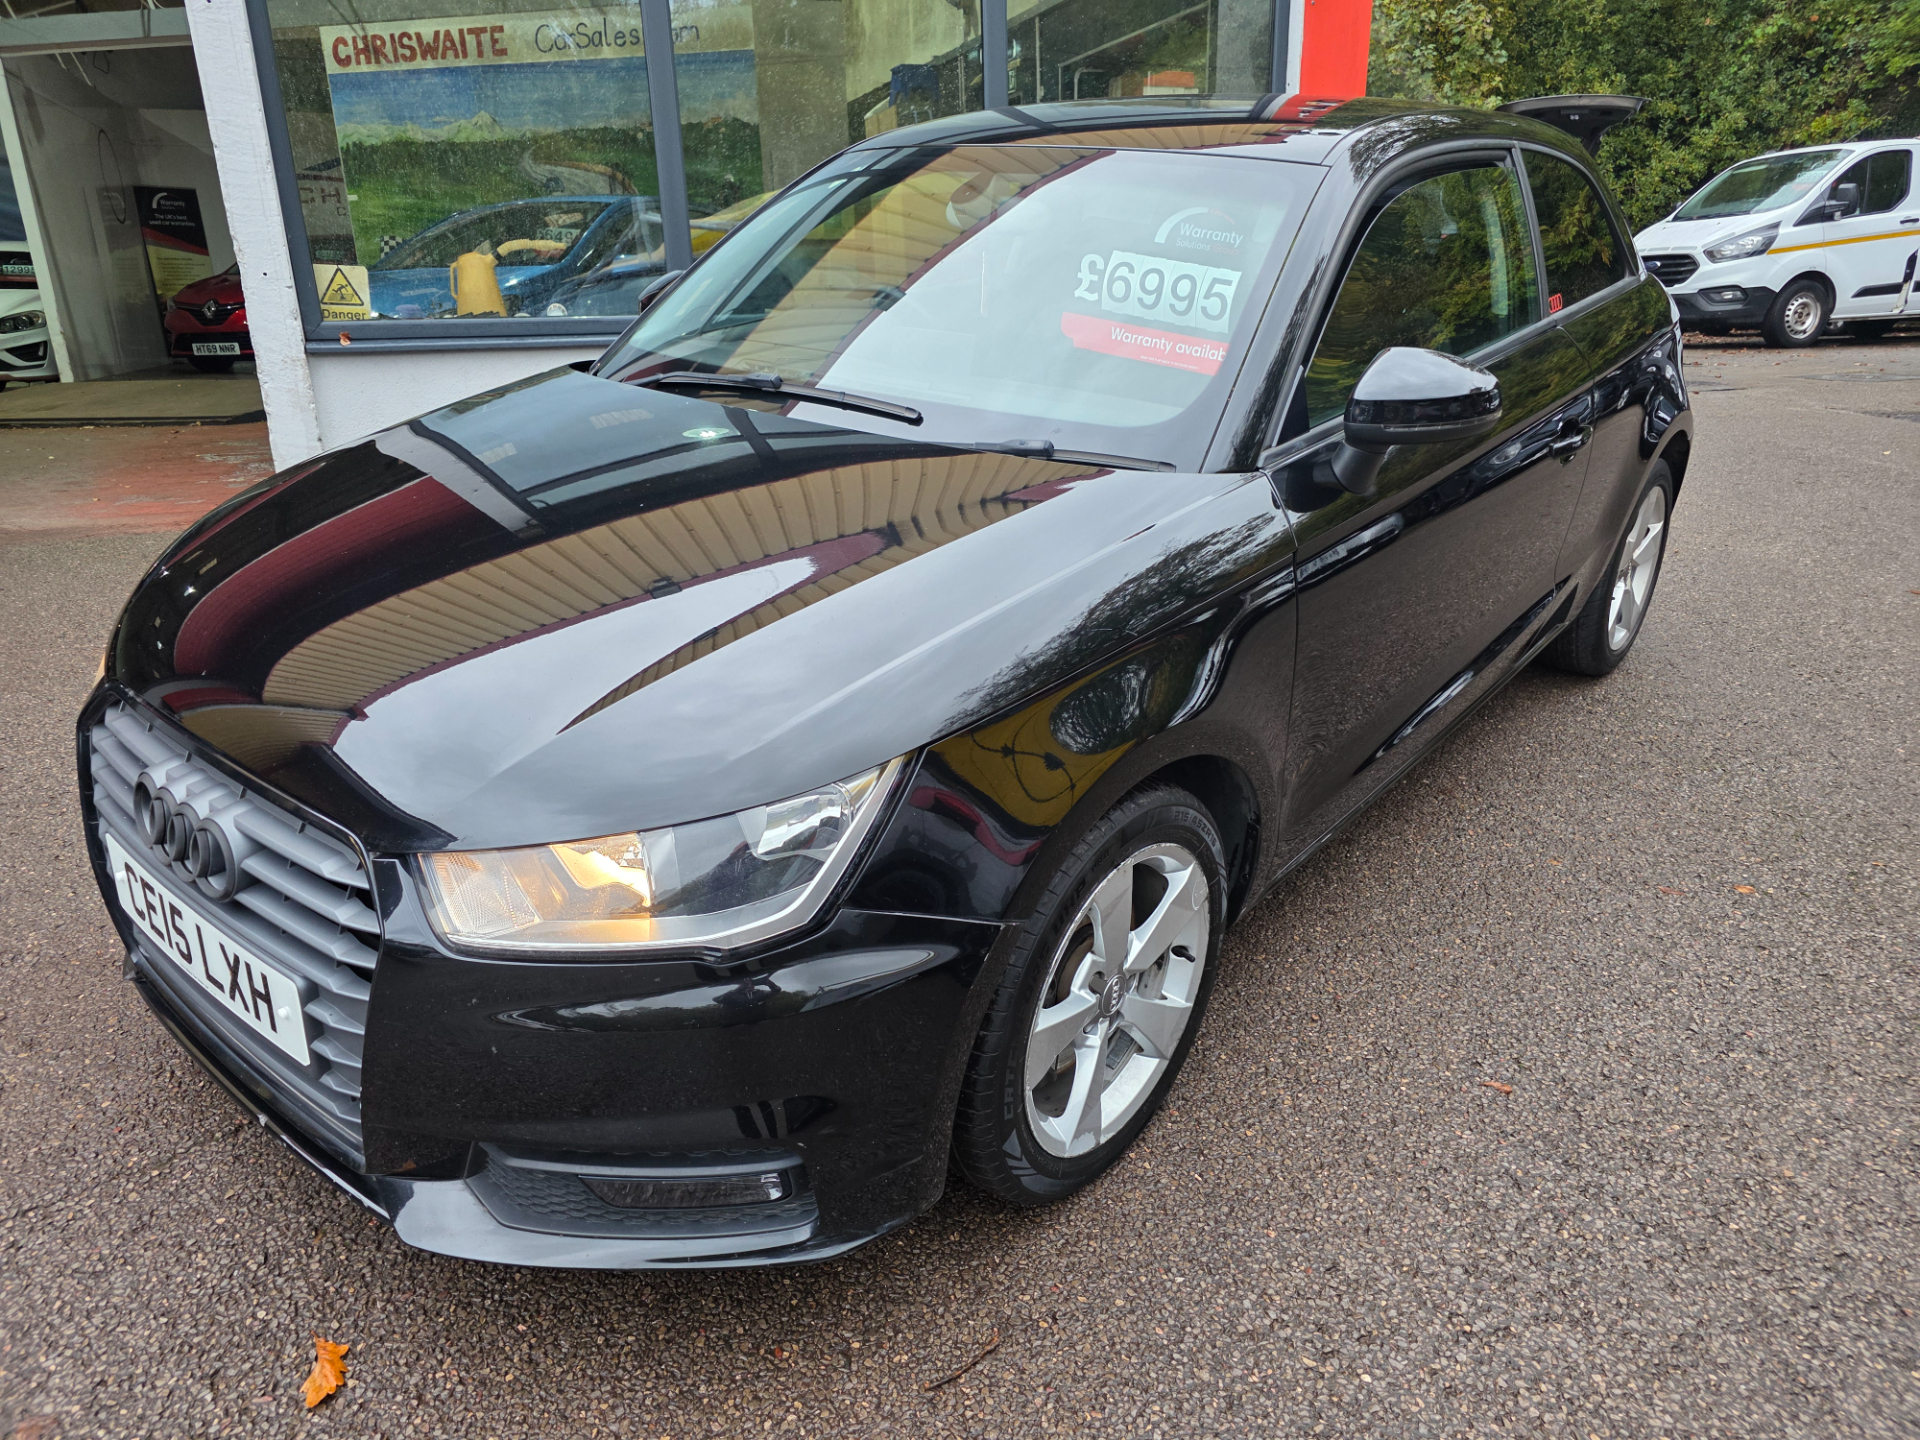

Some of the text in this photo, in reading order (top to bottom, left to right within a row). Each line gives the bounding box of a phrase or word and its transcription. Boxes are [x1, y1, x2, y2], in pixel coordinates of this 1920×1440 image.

[332, 25, 508, 68] CHRISWAITE
[1175, 237, 1240, 256] Solutions Group
[1180, 222, 1244, 248] Warranty
[1074, 253, 1233, 322] £6995
[323, 308, 366, 320] Danger
[195, 344, 236, 354] HT69 NNR
[1111, 326, 1227, 362] Warranty availab
[124, 861, 278, 1034] CE15 LXH
